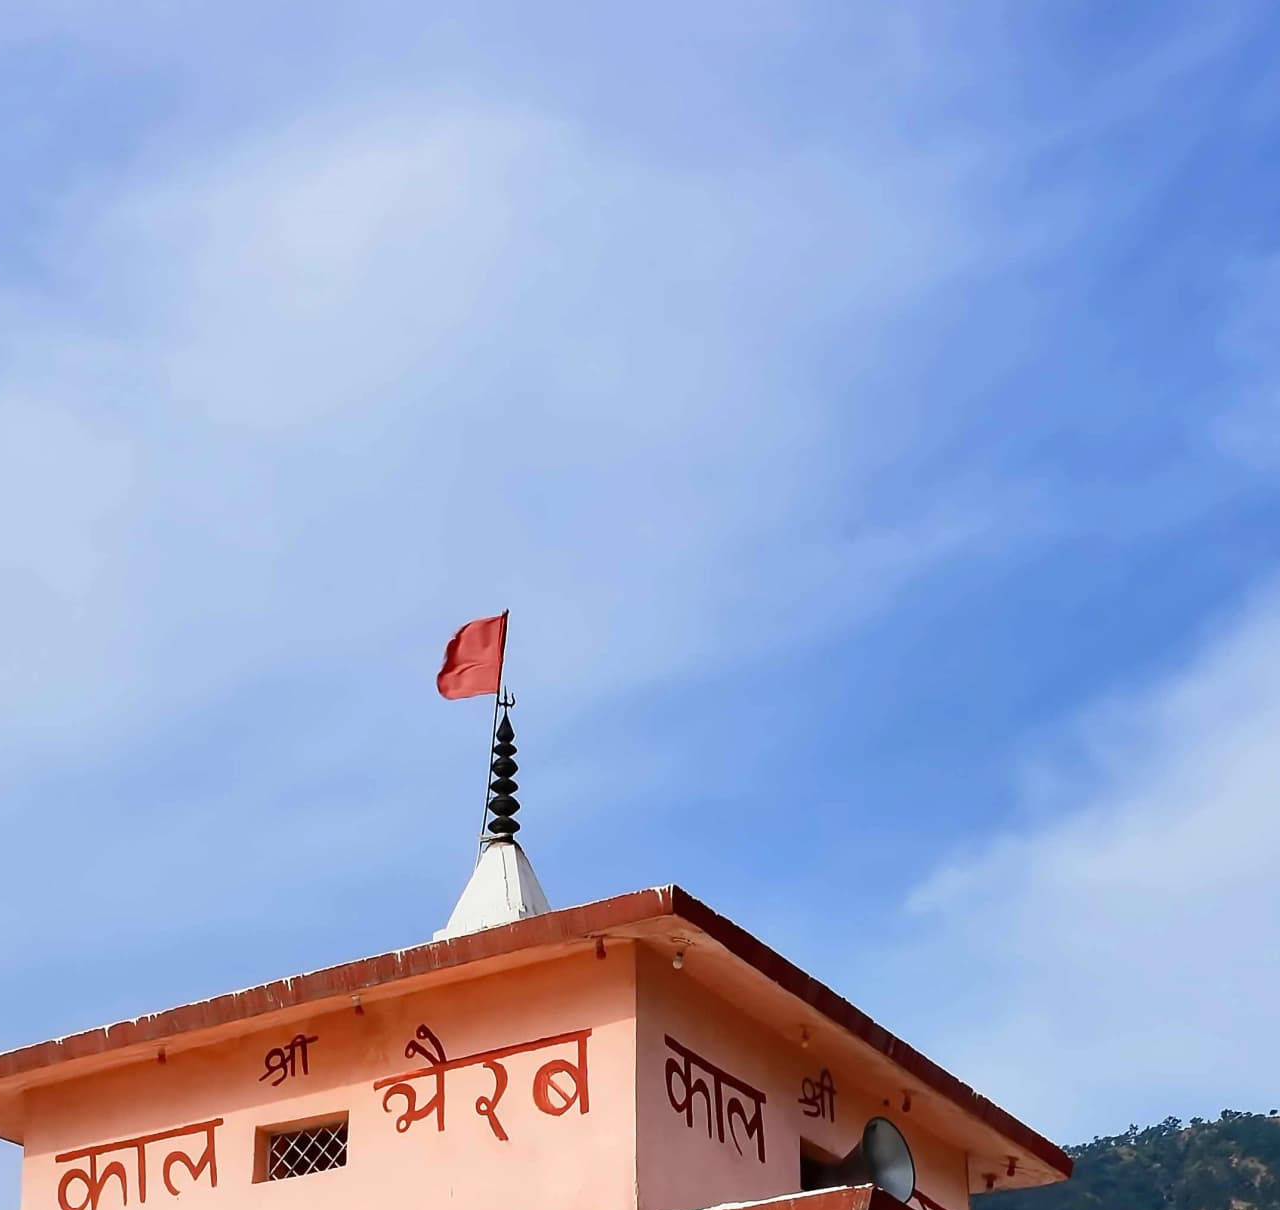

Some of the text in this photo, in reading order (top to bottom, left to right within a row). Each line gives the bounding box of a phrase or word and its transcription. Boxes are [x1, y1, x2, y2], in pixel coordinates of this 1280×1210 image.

[258, 1034, 319, 1087] श्री
[664, 1032, 767, 1164] काल
[798, 1068, 836, 1123] श्री
